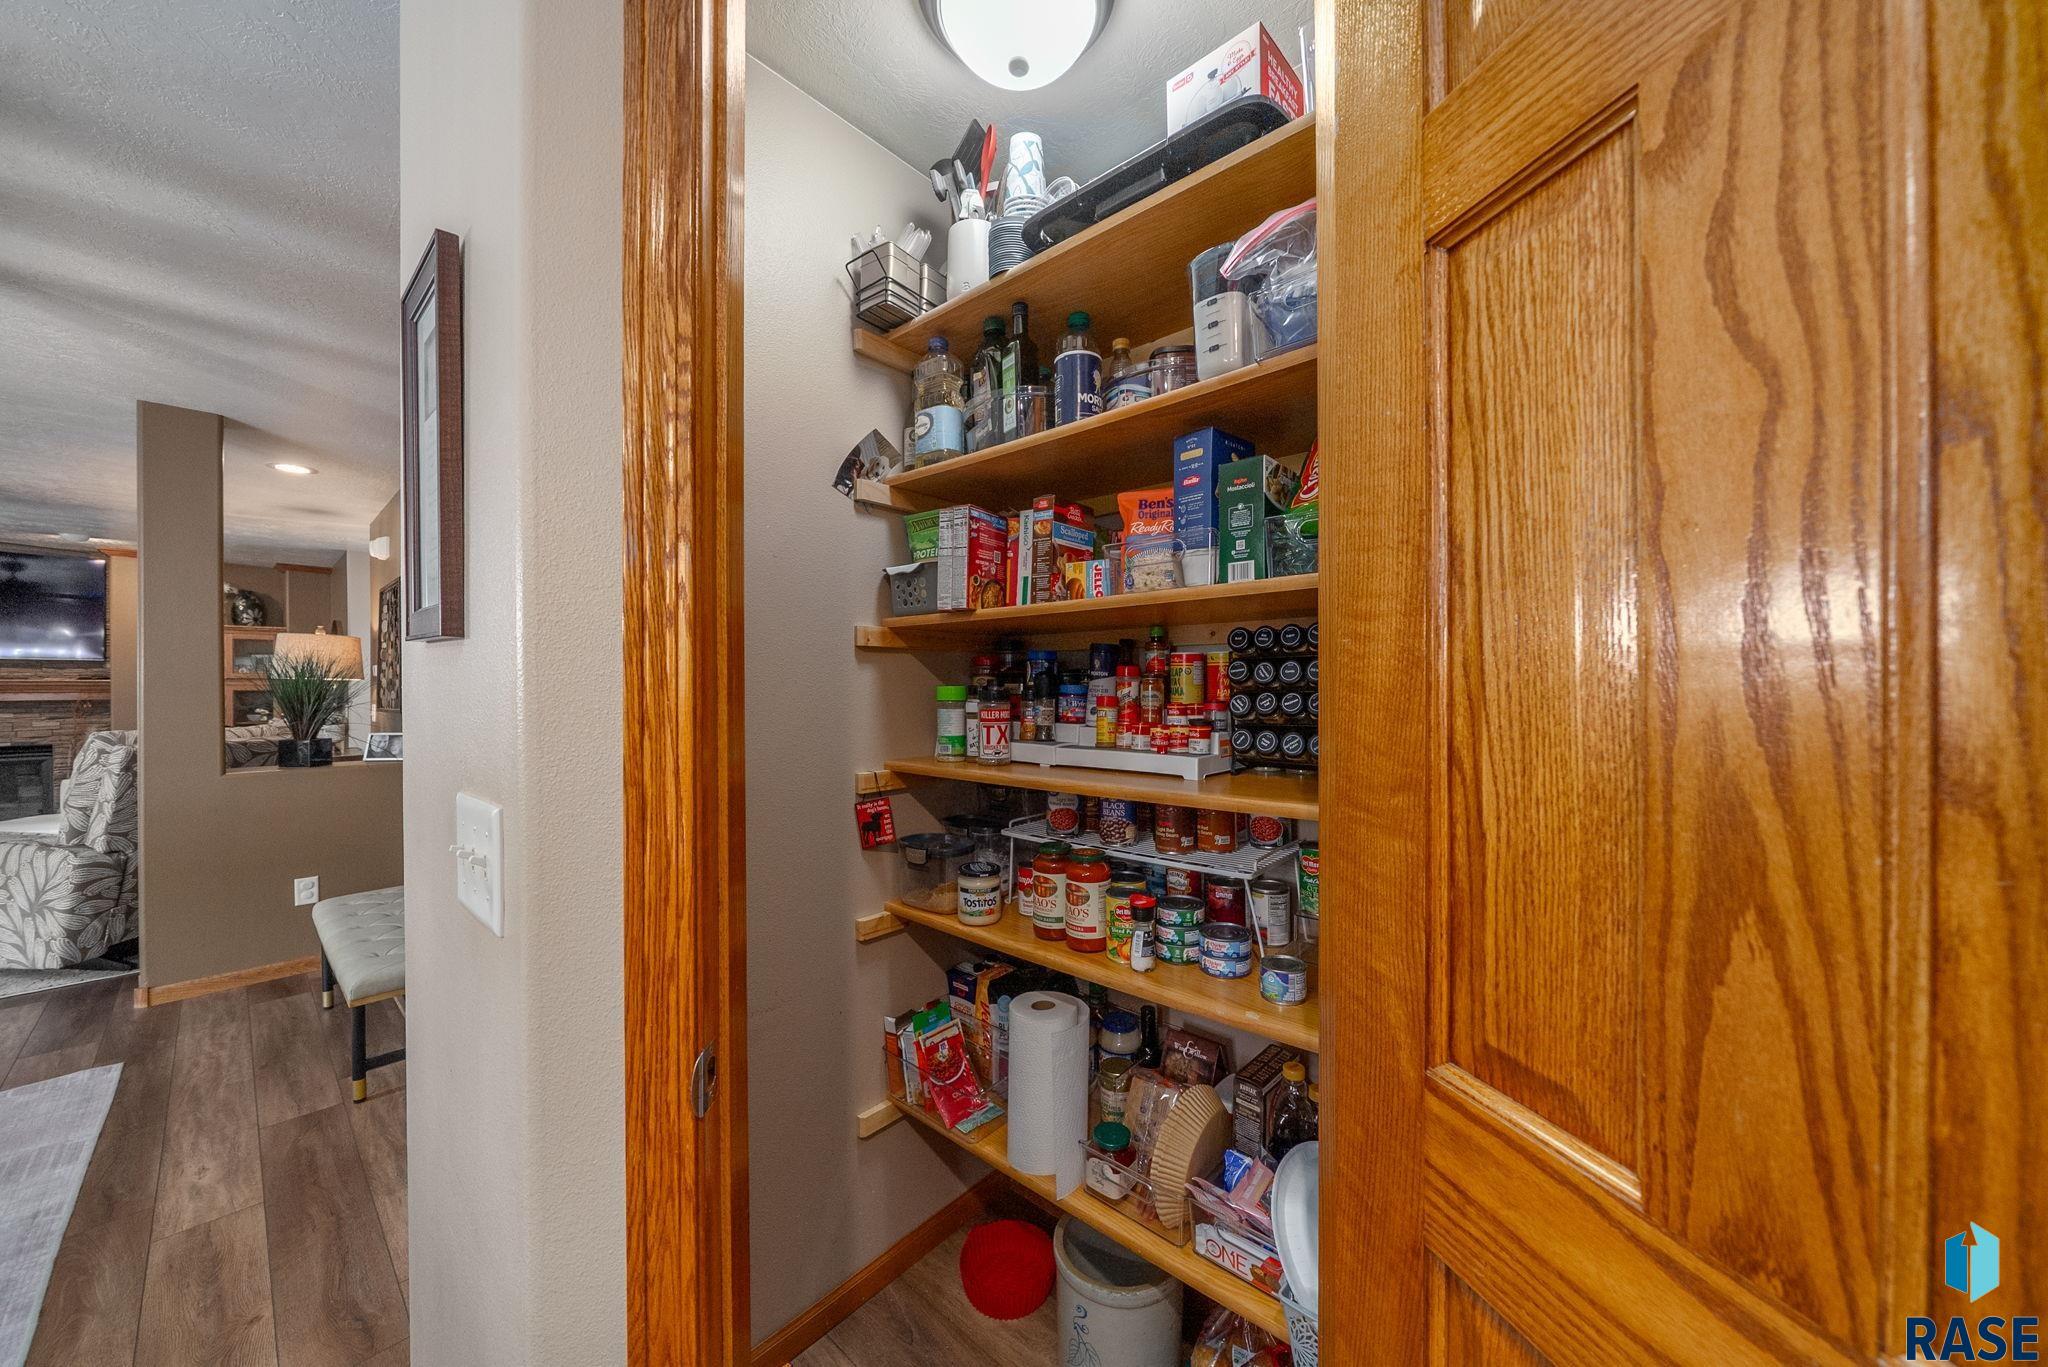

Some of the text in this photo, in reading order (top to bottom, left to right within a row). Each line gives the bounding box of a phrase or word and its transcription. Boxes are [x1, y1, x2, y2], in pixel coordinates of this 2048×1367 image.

[1138, 497, 1175, 510] Ben's
[1138, 510, 1174, 520] Original
[980, 710, 1000, 720] KILLER
[982, 724, 1009, 746] TX
[1102, 800, 1126, 810] BLACK
[1102, 809, 1126, 817] BEANS
[1205, 1238, 1248, 1277] ONE
